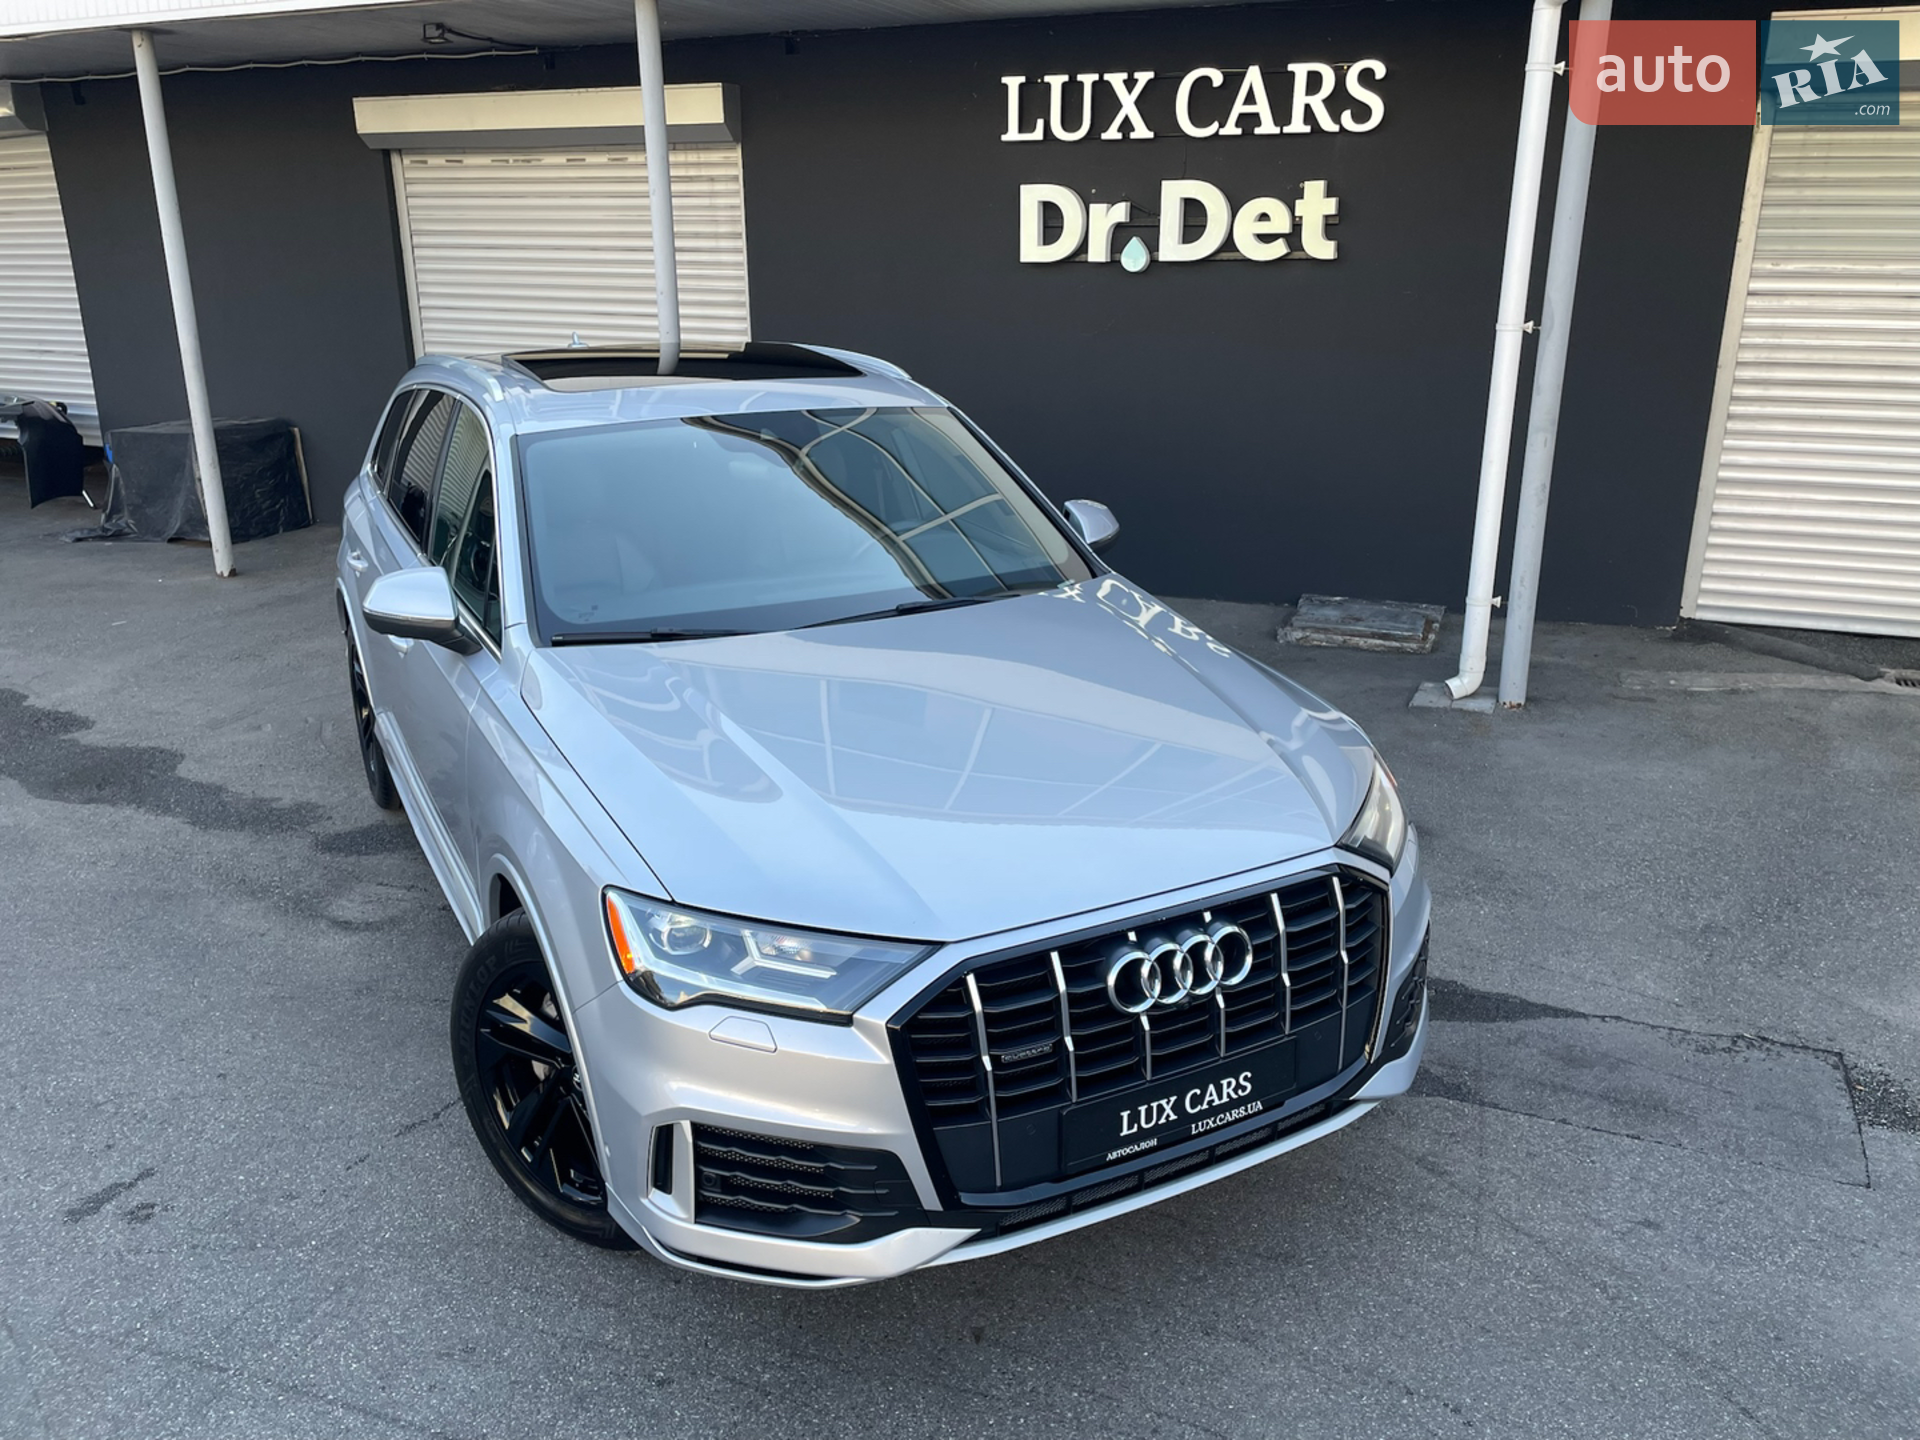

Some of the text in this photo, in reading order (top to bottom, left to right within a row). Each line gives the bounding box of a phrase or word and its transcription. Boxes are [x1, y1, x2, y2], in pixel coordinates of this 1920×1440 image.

[1000, 59, 1387, 141] LUX CARS
[460, 955, 498, 1048] DUNLOP
[1119, 1071, 1252, 1136] LUX CARS
[1191, 1100, 1263, 1135] LUX.CARS.UA
[1106, 1138, 1157, 1161] АВТОСАЛОН
